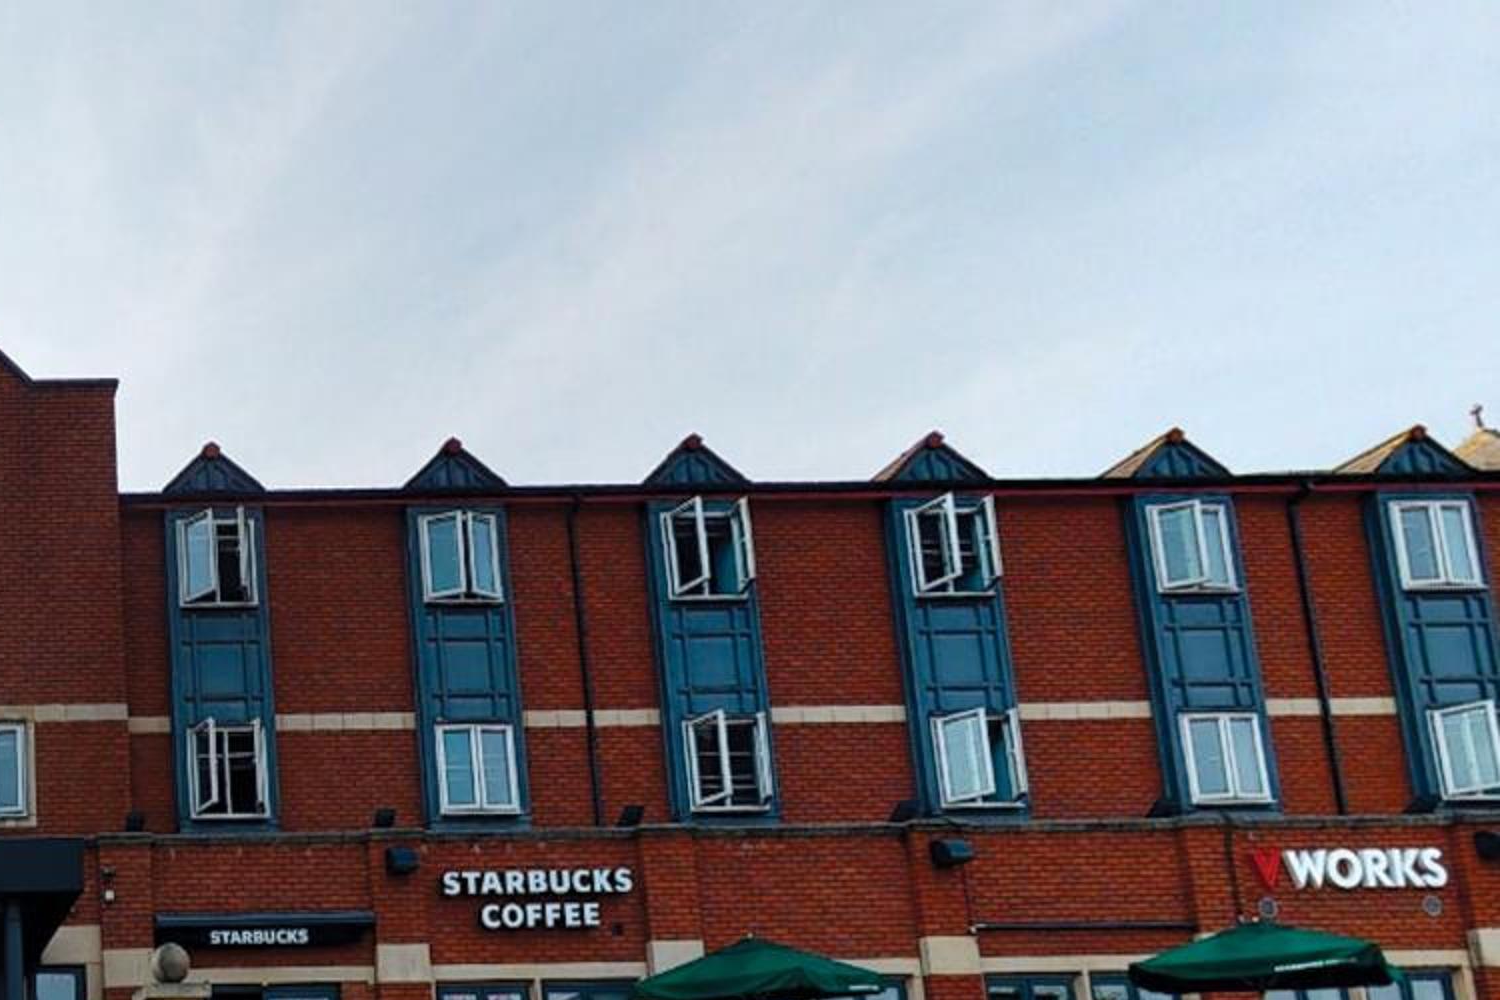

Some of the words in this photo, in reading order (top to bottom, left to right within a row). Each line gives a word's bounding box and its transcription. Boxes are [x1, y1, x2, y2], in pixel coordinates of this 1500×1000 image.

[442, 867, 634, 896] STARBUCKS
[481, 902, 601, 928] COFFEE
[209, 928, 310, 945] STARBUCKS
